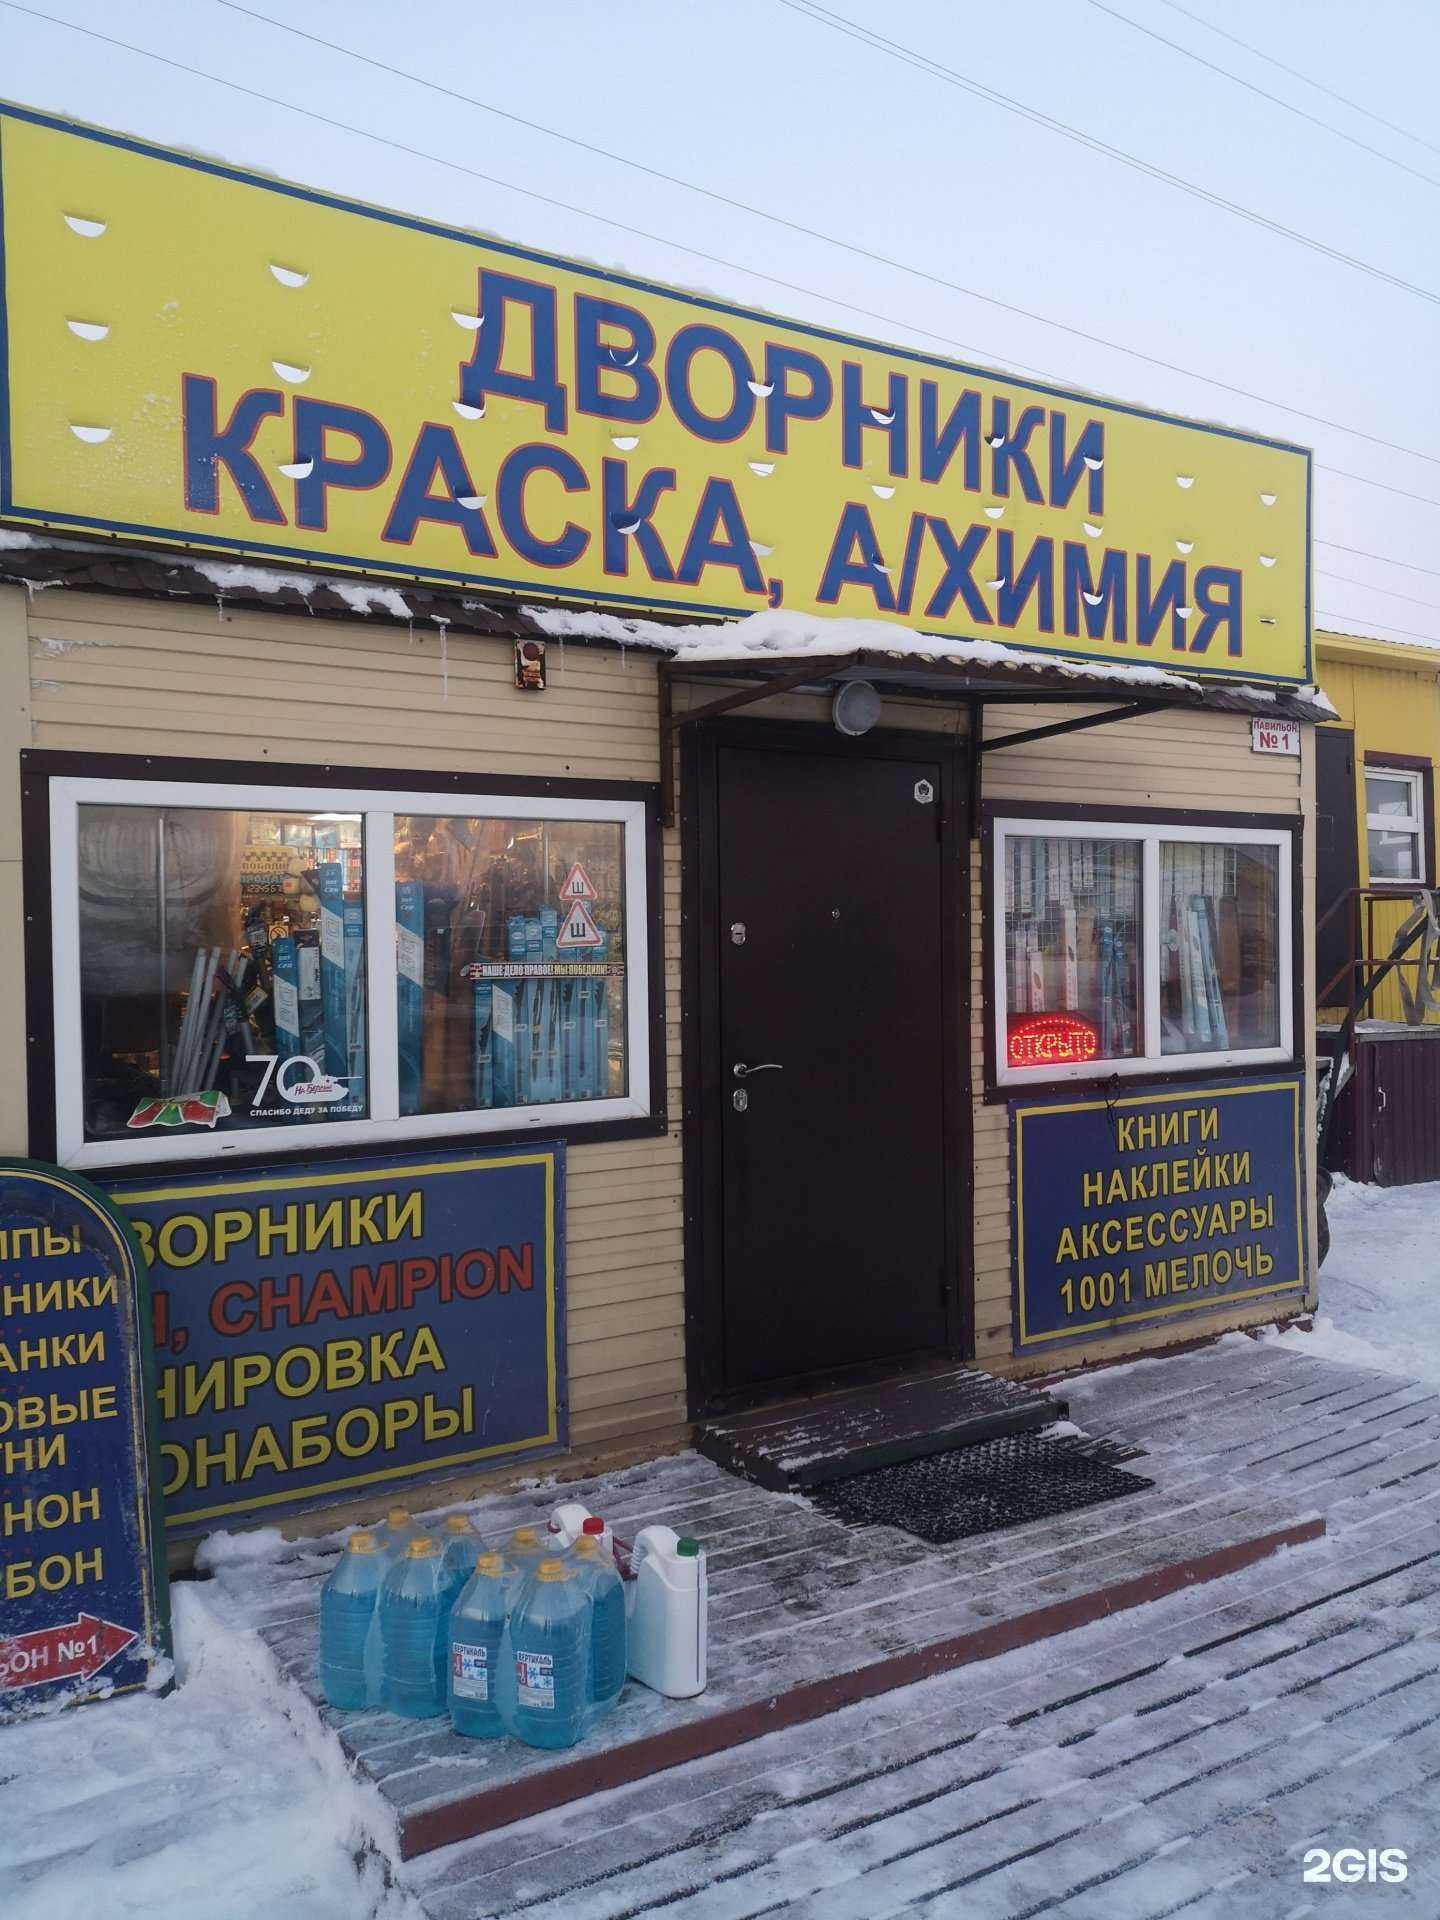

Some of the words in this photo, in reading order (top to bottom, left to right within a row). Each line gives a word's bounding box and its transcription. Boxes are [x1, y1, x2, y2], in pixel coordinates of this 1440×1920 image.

[460, 267, 1104, 516] ДВОРНИКИ
[182, 372, 783, 609] КРАСКА,
[816, 501, 1243, 657] А/ХИМИЯ
[1253, 720, 1297, 732] ПАВИЛЬОН
[572, 881, 584, 894] Ш
[570, 922, 586, 938] Ш
[482, 965, 503, 976] НАШЕ
[504, 965, 523, 977] ДЕЛО
[524, 965, 553, 976] ПРАВОЕ!
[554, 965, 568, 976] МЫ
[1010, 1031, 1095, 1059] ОТКРЫТО
[245, 1054, 321, 1107] 70
[250, 1108, 291, 1117] СПАСИБО
[293, 1106, 315, 1115] ДЕДУ
[330, 1105, 363, 1113] ПОБЕДУ
[1117, 1107, 1219, 1152] КНИГИ
[1082, 1148, 1250, 1208] НАКЛЕЙКИ
[0, 1224, 81, 1260] ПЫ
[1055, 1195, 1274, 1264] АКСЕССУАРЫ
[208, 1242, 535, 1337] CHAMPION
[1059, 1268, 1132, 1315] 1001
[1145, 1243, 1274, 1299] МЕЛОЧЬ
[0, 1433, 66, 1475] НИ
[58, 1635, 97, 1663] №1
[454, 1644, 486, 1657] ВЕРТИКАЛЬ
[518, 1652, 552, 1666] ВЕРТИКАЛЬ
